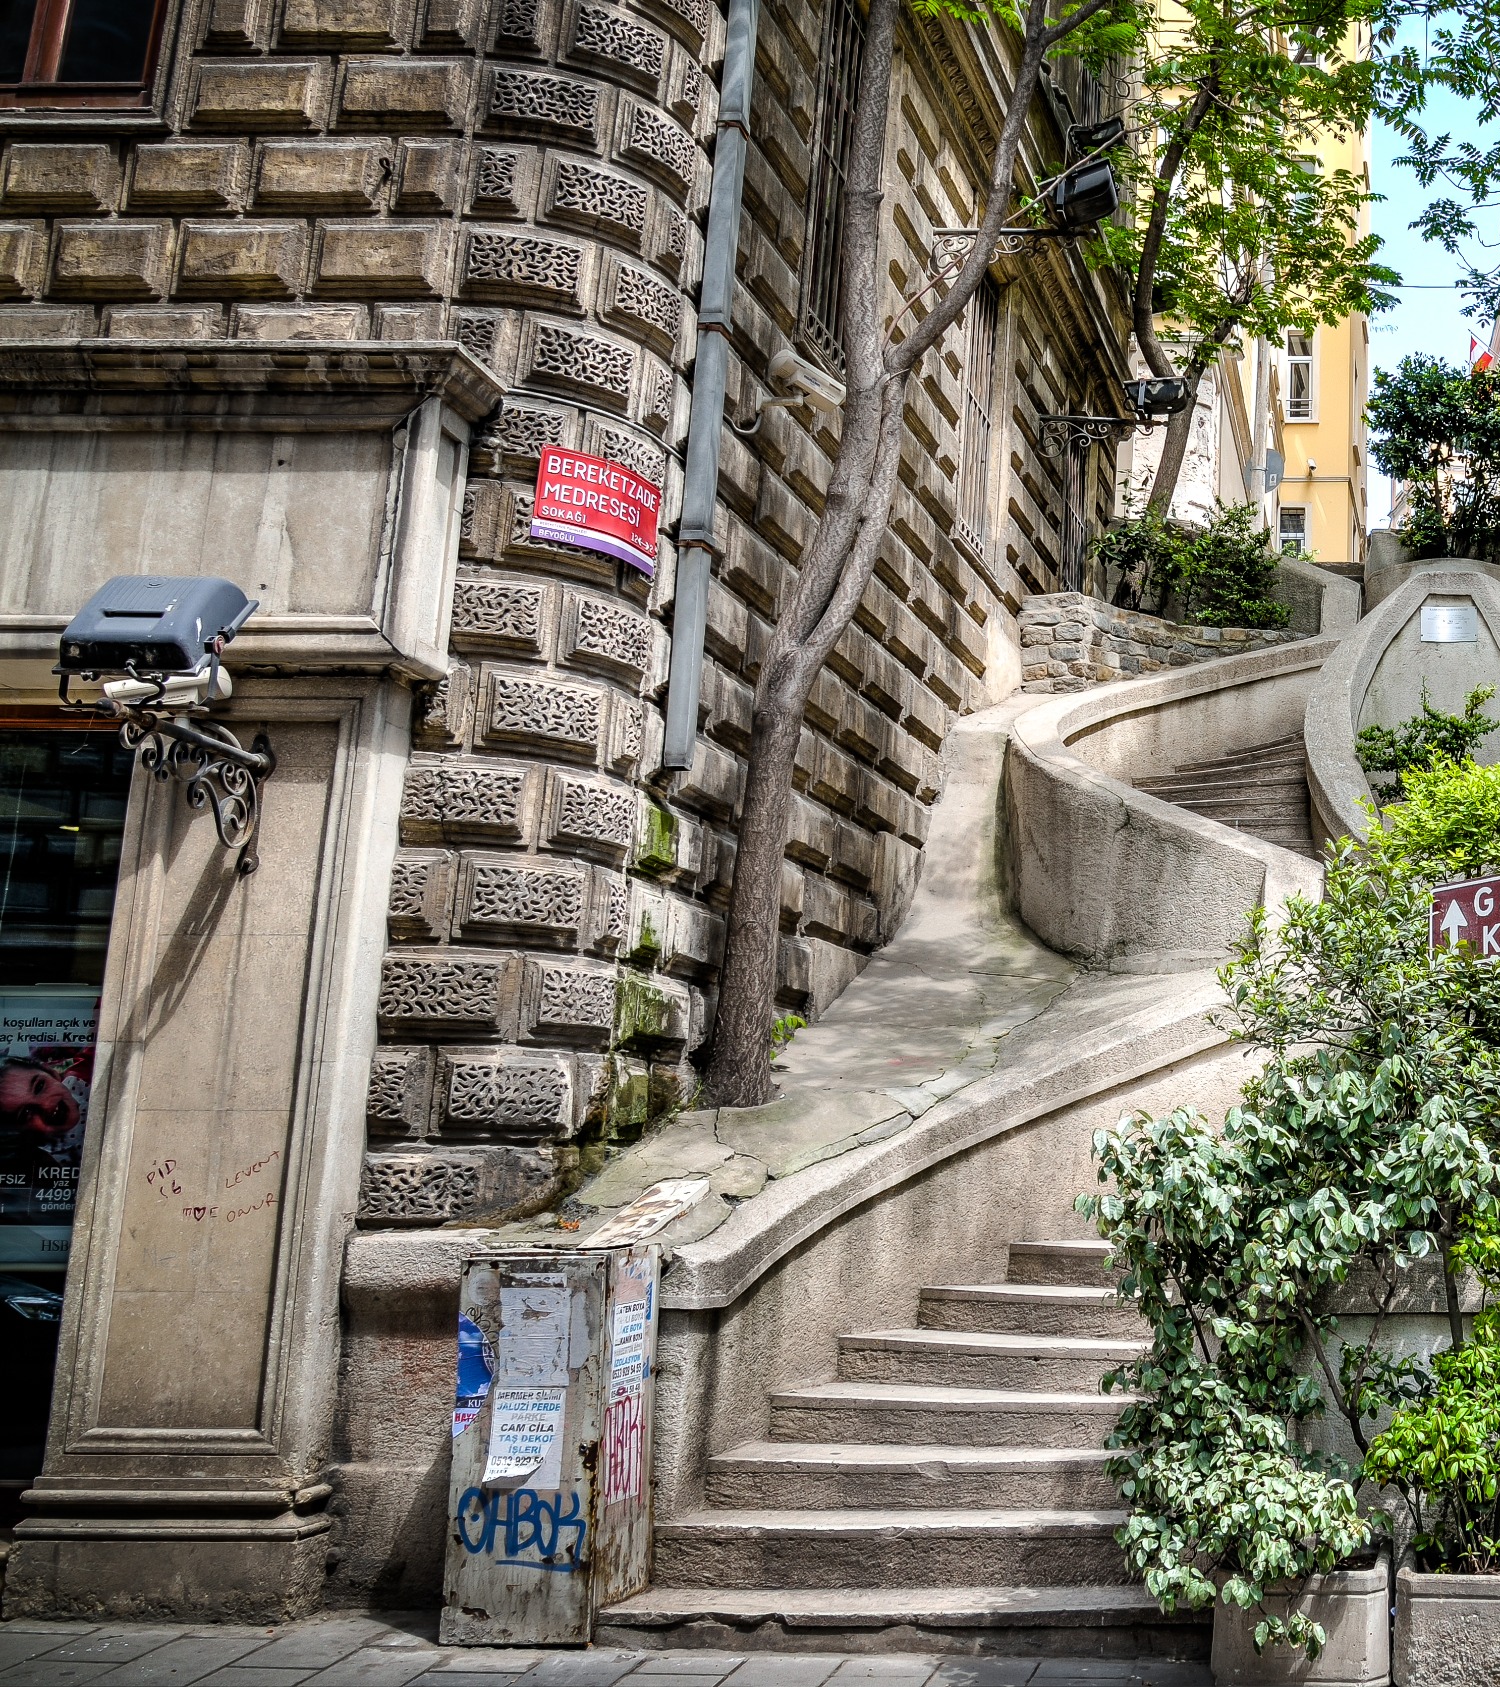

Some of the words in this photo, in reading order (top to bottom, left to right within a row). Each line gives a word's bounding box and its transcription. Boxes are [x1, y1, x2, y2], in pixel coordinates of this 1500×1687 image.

[547, 455, 657, 513] BEREKETZADE
[542, 481, 641, 527] MEDRESESİ
[541, 505, 587, 524] SOKAĞI
[538, 528, 576, 543] BEYOĞLU
[55, 1017, 80, 1031] açık
[82, 1019, 96, 1028] ve
[17, 1031, 60, 1043] kredisi.
[53, 1180, 70, 1189] yaz
[41, 1201, 76, 1212] gönder
[496, 1401, 530, 1411] JALUZİ
[531, 1402, 561, 1412] PERDE
[510, 1413, 547, 1421] PARKE
[500, 1423, 526, 1432] CAM
[528, 1421, 554, 1432] CİLA
[499, 1434, 519, 1444] TAŞ
[508, 1444, 542, 1454] İŞLERİ
